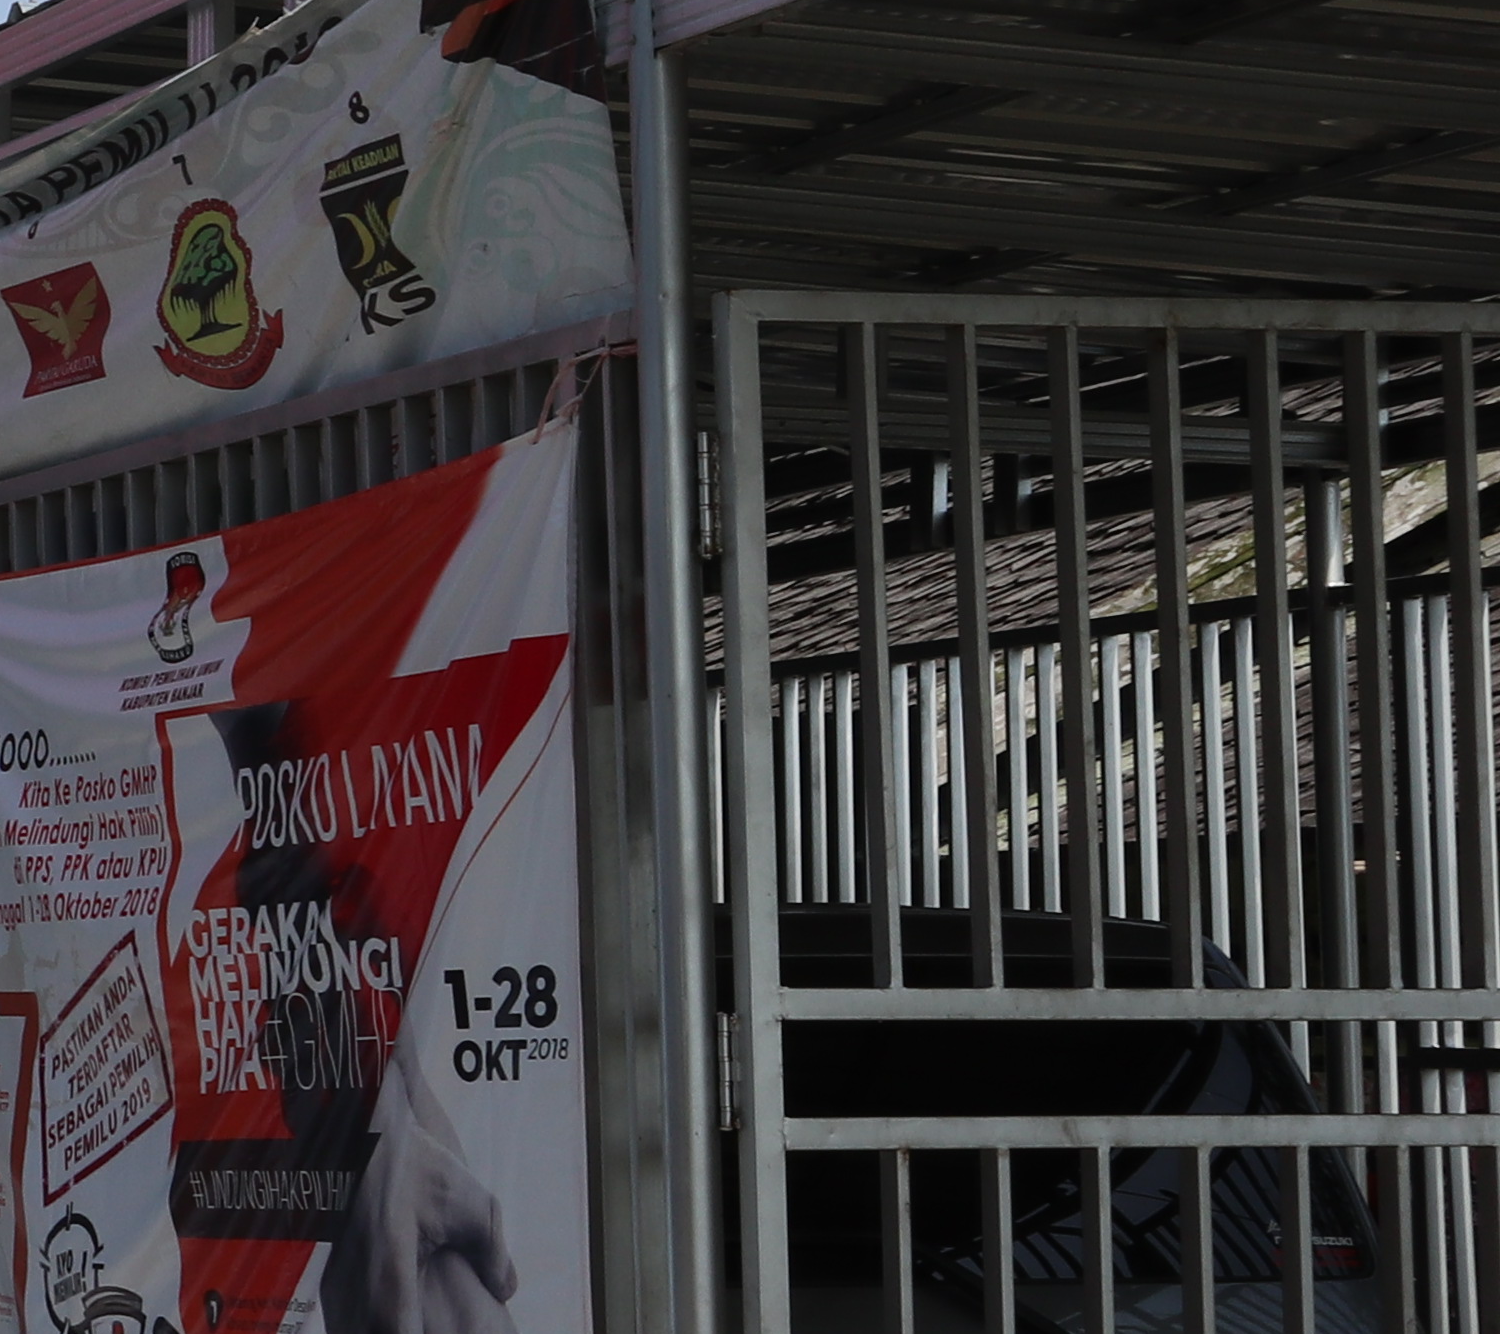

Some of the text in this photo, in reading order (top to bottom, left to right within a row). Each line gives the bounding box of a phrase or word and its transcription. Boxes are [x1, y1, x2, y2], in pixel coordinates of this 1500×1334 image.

[349, 91, 369, 123] 8
[172, 155, 194, 186] 7
[352, 142, 399, 172] KEADILAN
[19, 765, 157, 808] Kita Ke Posko GMHP
[5, 805, 165, 850] Melindungi Hak Pilih)
[25, 848, 167, 886] PPS, PPK atau KPU
[54, 887, 159, 920] Oktober 2018
[445, 965, 558, 1031] 1-28
[52, 966, 137, 1079] PASTIKAN ANDA
[68, 1013, 134, 1100] TERDAFTAR
[454, 1037, 569, 1082] OKT 2018
[48, 1082, 109, 1149] SEBAGAI
[110, 1028, 159, 1098] PEMILIH
[64, 1077, 152, 1171] PEMILU 2019
